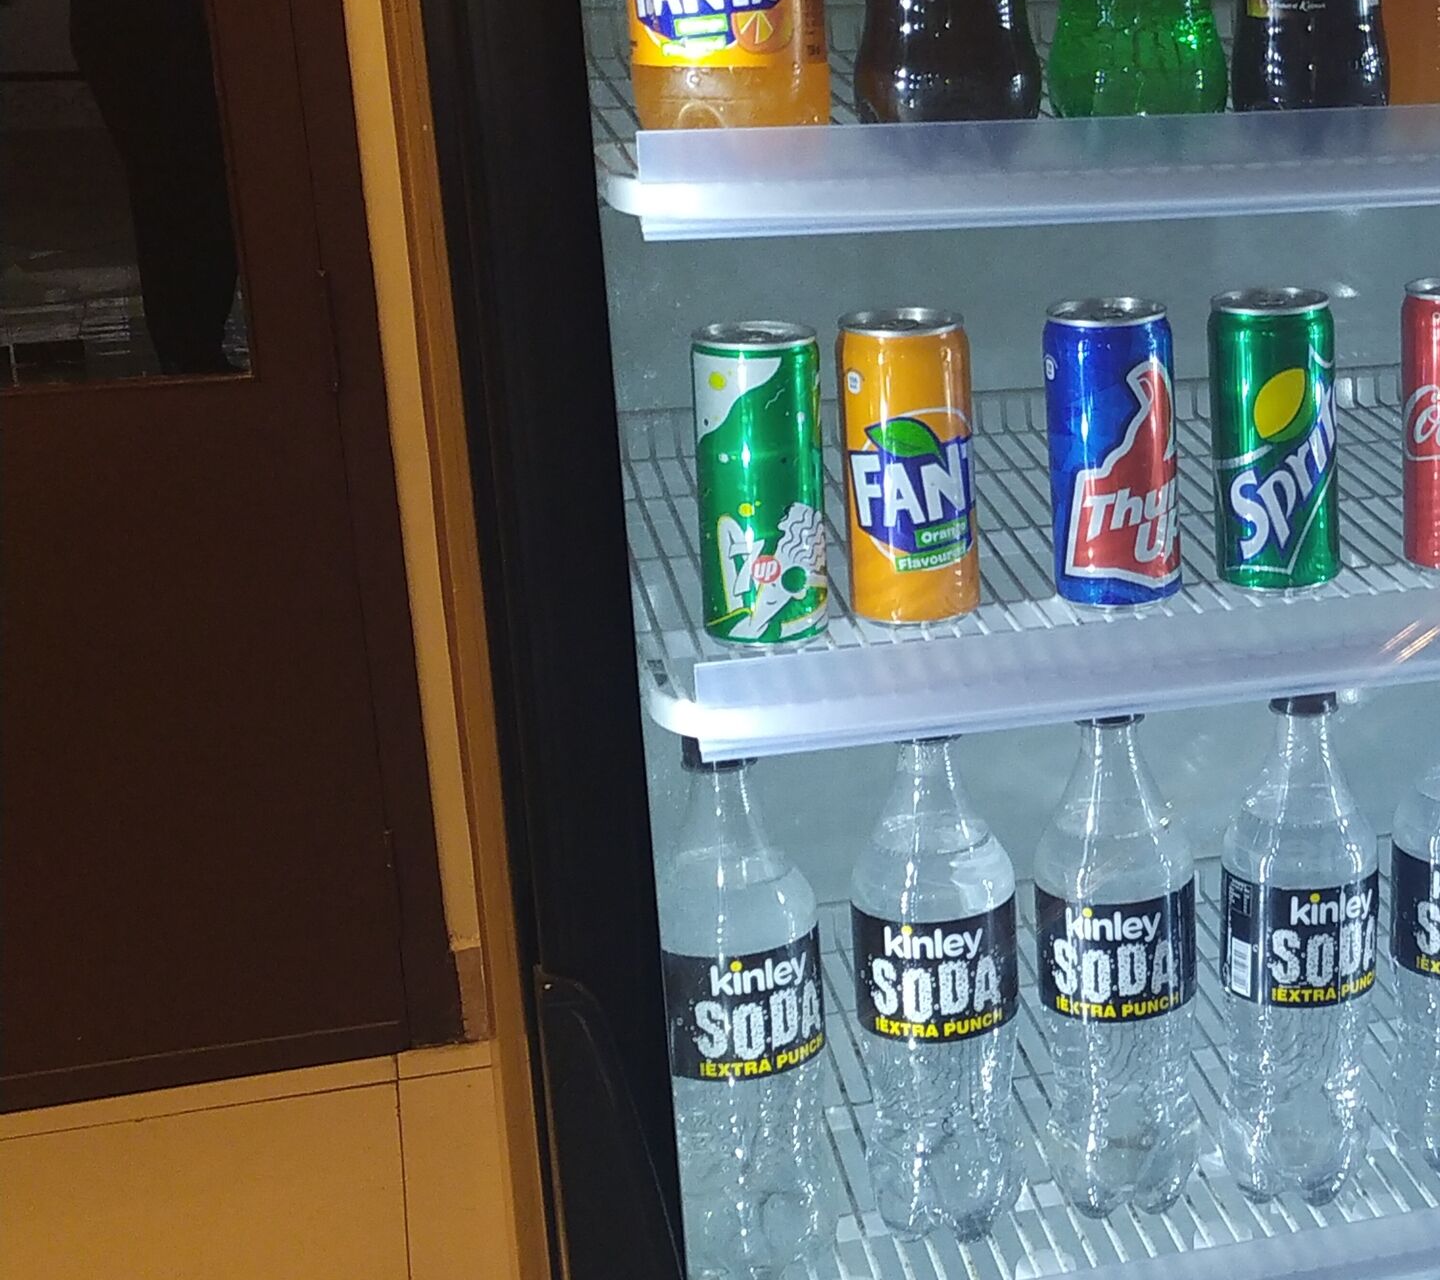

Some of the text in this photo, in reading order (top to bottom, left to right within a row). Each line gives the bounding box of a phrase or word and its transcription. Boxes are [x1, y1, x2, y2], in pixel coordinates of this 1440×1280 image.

[1230, 380, 1337, 560] Sprit
[1082, 482, 1177, 542] Thu
[1065, 907, 1161, 942] kinley
[1290, 888, 1373, 926] kinley
[884, 925, 984, 960] kinley
[1271, 915, 1376, 988] SODA
[710, 952, 806, 997] kinley
[872, 955, 1001, 1023] SODA
[1053, 938, 1179, 1004] SODA
[695, 980, 821, 1060] SODA
[944, 1008, 1003, 1037] PUNCH
[1121, 991, 1179, 1018] PUNCH
